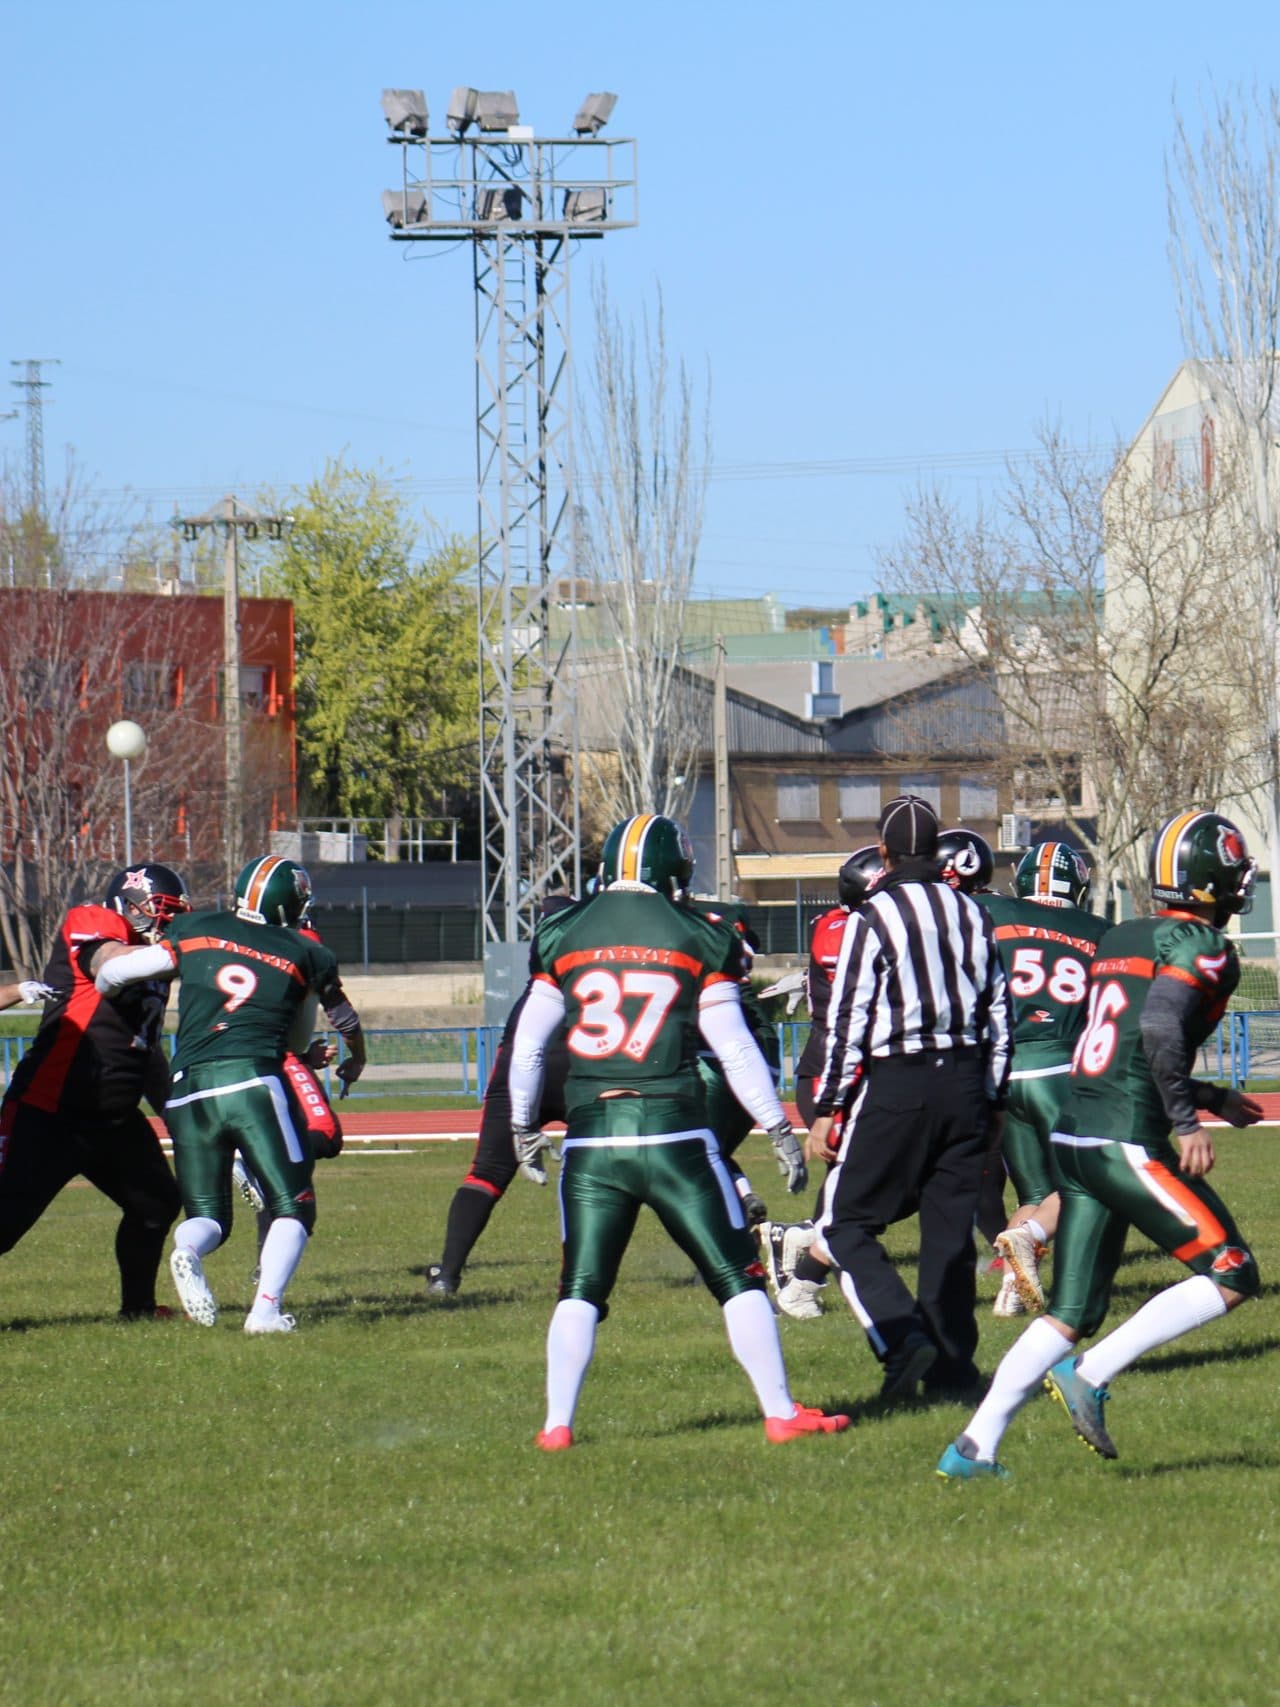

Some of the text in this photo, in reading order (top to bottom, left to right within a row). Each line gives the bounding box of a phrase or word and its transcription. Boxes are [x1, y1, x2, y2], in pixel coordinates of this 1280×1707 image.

[215, 963, 257, 1014] 9
[1009, 947, 1087, 1005] 58
[567, 968, 683, 1063] 37
